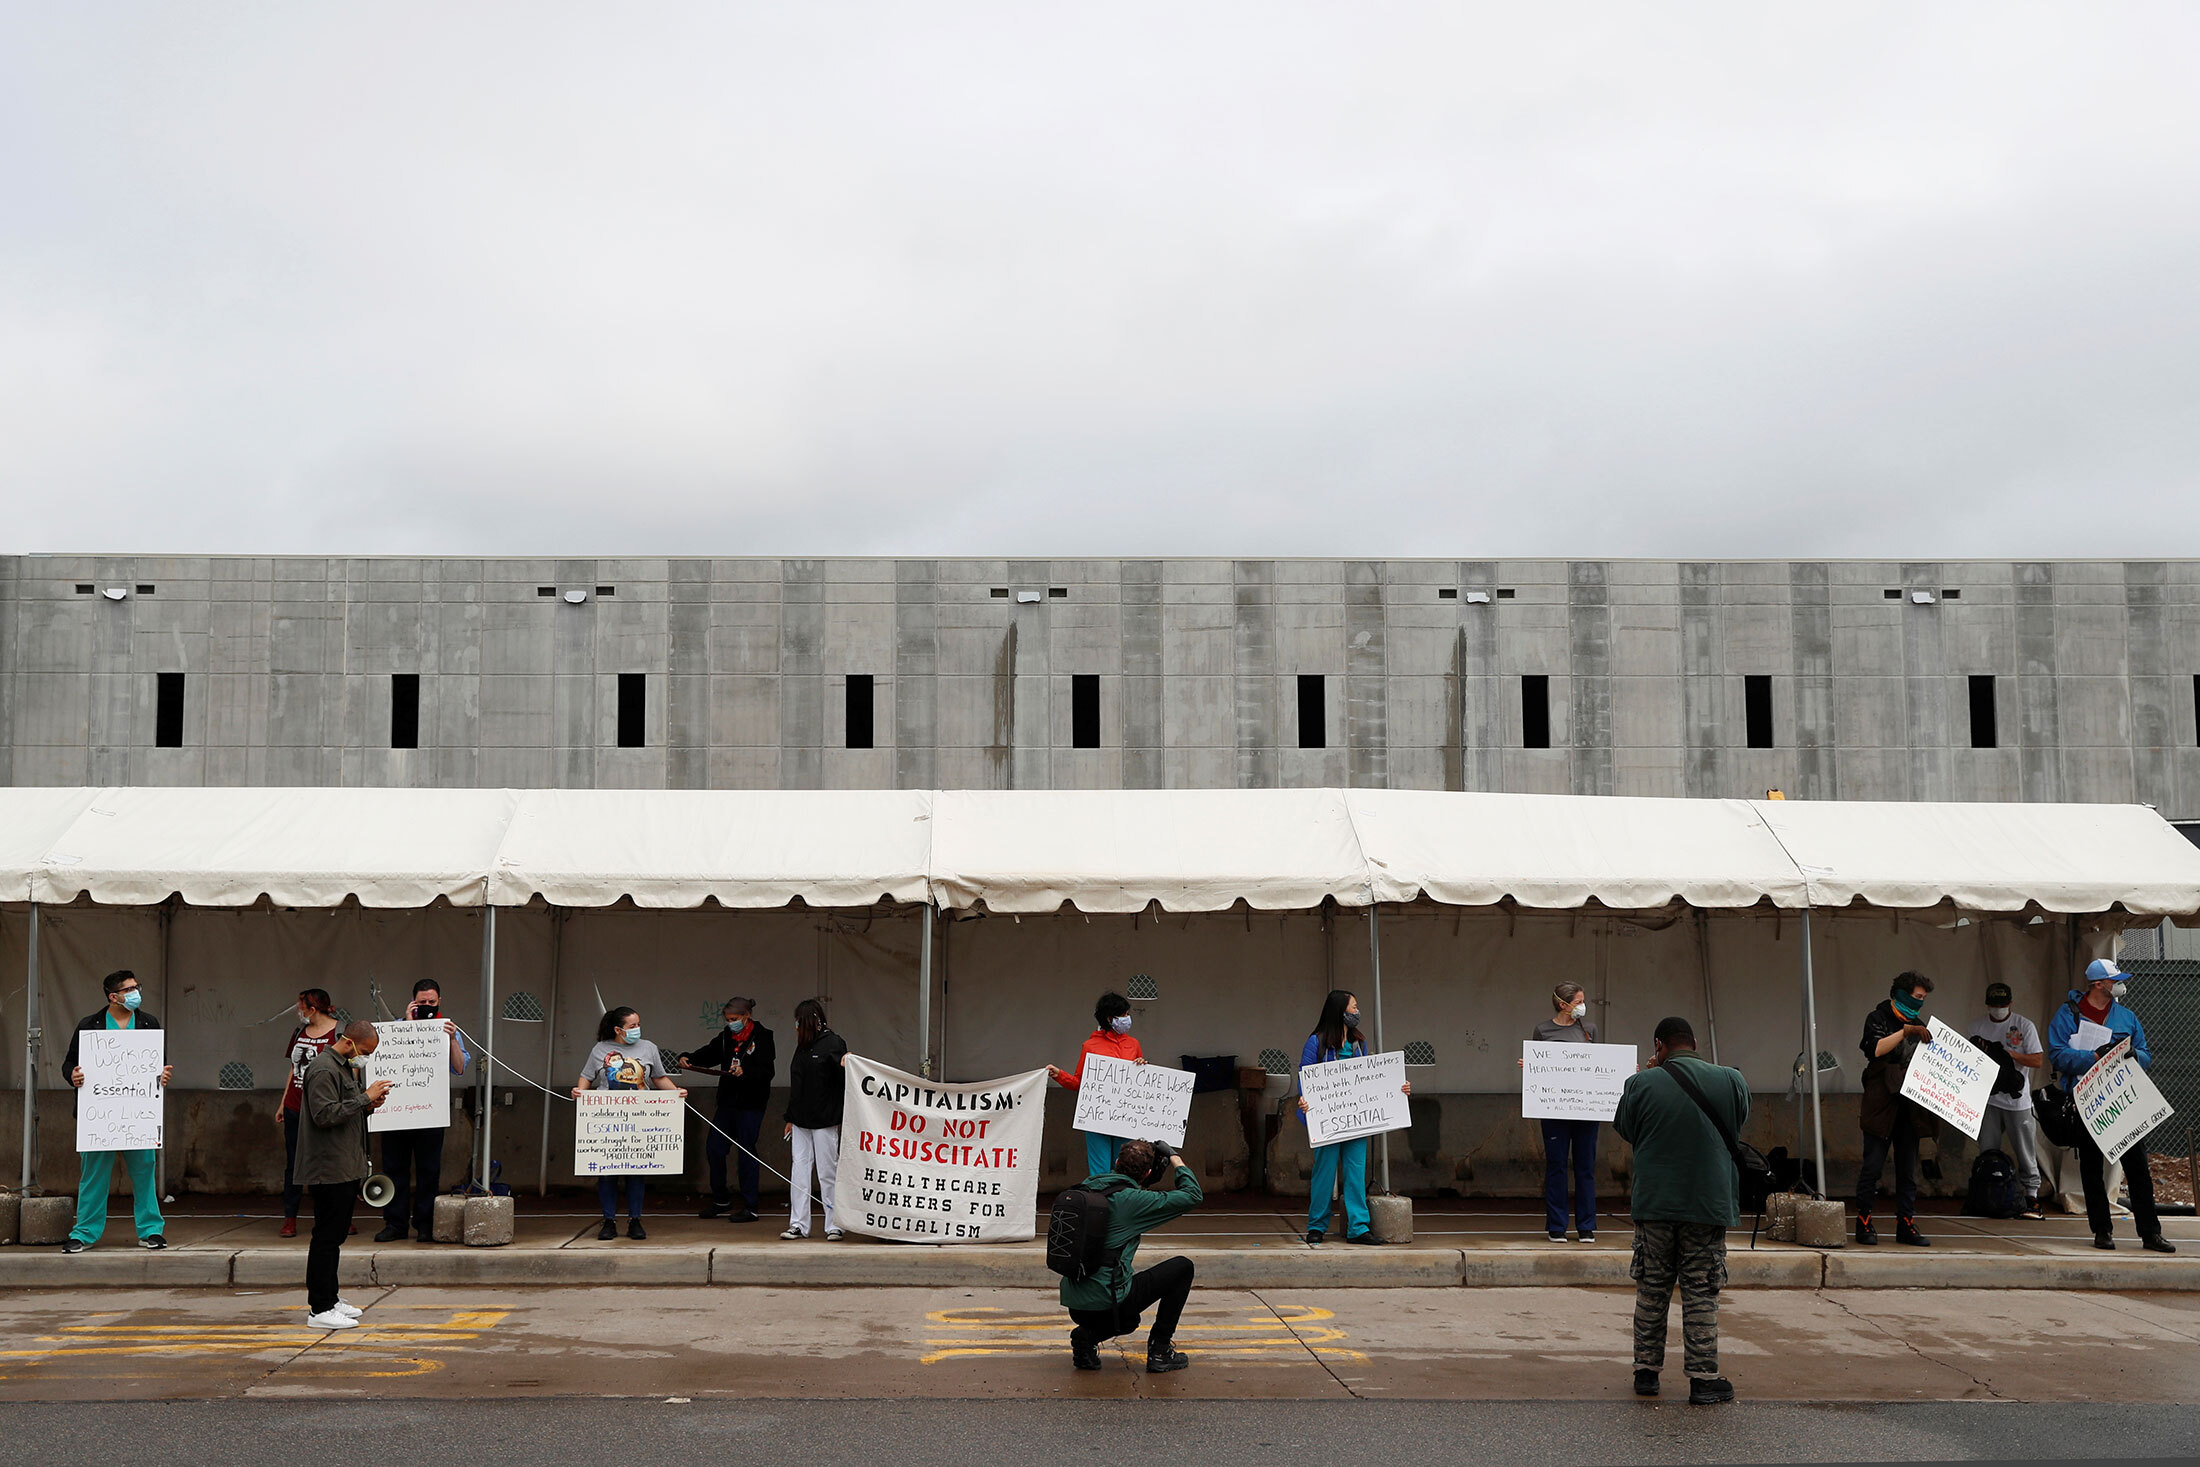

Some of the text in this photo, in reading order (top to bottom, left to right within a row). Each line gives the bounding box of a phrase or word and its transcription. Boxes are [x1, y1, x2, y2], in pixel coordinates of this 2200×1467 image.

[416, 1023, 442, 1033] Workers
[83, 1032, 121, 1051] The
[382, 1039, 390, 1047] in
[428, 1037, 441, 1045] with
[1936, 1027, 1972, 1054] TRUMP
[95, 1048, 159, 1068] Working
[374, 1050, 405, 1061] Amazon
[1533, 1048, 1552, 1059] WE
[1927, 1040, 1980, 1082] DEMOCRATS
[115, 1062, 157, 1077] Class
[374, 1064, 434, 1078] We're Fighting
[1135, 1068, 1164, 1089] CARE
[1304, 1056, 1400, 1081] NYC healthcare Workers
[1529, 1063, 1577, 1074] HEALTHCARE
[1922, 1052, 1969, 1086] ENEMIES OF
[406, 1076, 430, 1088] Lives!
[1082, 1082, 1104, 1093] ARE
[1332, 1077, 1351, 1089] with
[1354, 1072, 1386, 1086] Amazon
[1913, 1069, 1931, 1086] BUILD
[1938, 1088, 1956, 1102] CLASS
[1929, 1069, 1961, 1094] WORKERS
[2076, 1065, 2100, 1094] AMAZON
[2079, 1083, 2095, 1105] SHUT
[2096, 1074, 2103, 1086] IT
[861, 1075, 1023, 1111] CAPITALISM:
[1541, 1086, 1556, 1094] NYC
[2084, 1064, 2134, 1120] CLEAN IT UP!
[582, 1095, 639, 1106] HEALTHCARE
[1096, 1095, 1112, 1106] The
[1162, 1104, 1178, 1117] for
[1328, 1101, 1358, 1114] Working
[1359, 1094, 1379, 1103] Class
[1906, 1086, 1977, 1134] INTERNATIONALIST GROUP
[1920, 1084, 1975, 1122] WORKERS PARTY
[2090, 1084, 2139, 1136] UNIONIZE!
[86, 1106, 156, 1121] Our Lives
[591, 1108, 629, 1122] solidarity
[1109, 1109, 1138, 1129] Working
[1320, 1108, 1394, 1135] ESSENTIAL
[108, 1122, 136, 1133] Over
[586, 1122, 639, 1134] ESSENTIAL
[890, 1110, 991, 1139] DO NOT
[2107, 1106, 2167, 1161] INTERNATIONALIST GROUP
[577, 1146, 607, 1157] working
[608, 1145, 645, 1153] conditions
[650, 1143, 679, 1152] BETTER
[600, 1136, 627, 1147] struggle
[631, 1135, 642, 1144] for
[646, 1134, 683, 1143] BETTER
[859, 1131, 1018, 1169] RESUSCITATE
[606, 1152, 655, 1160] PROTECTION!
[864, 1168, 1001, 1196] HEALTHCARE
[862, 1187, 1006, 1218] WORKERS FOR
[866, 1213, 981, 1239] SOCIALISM
